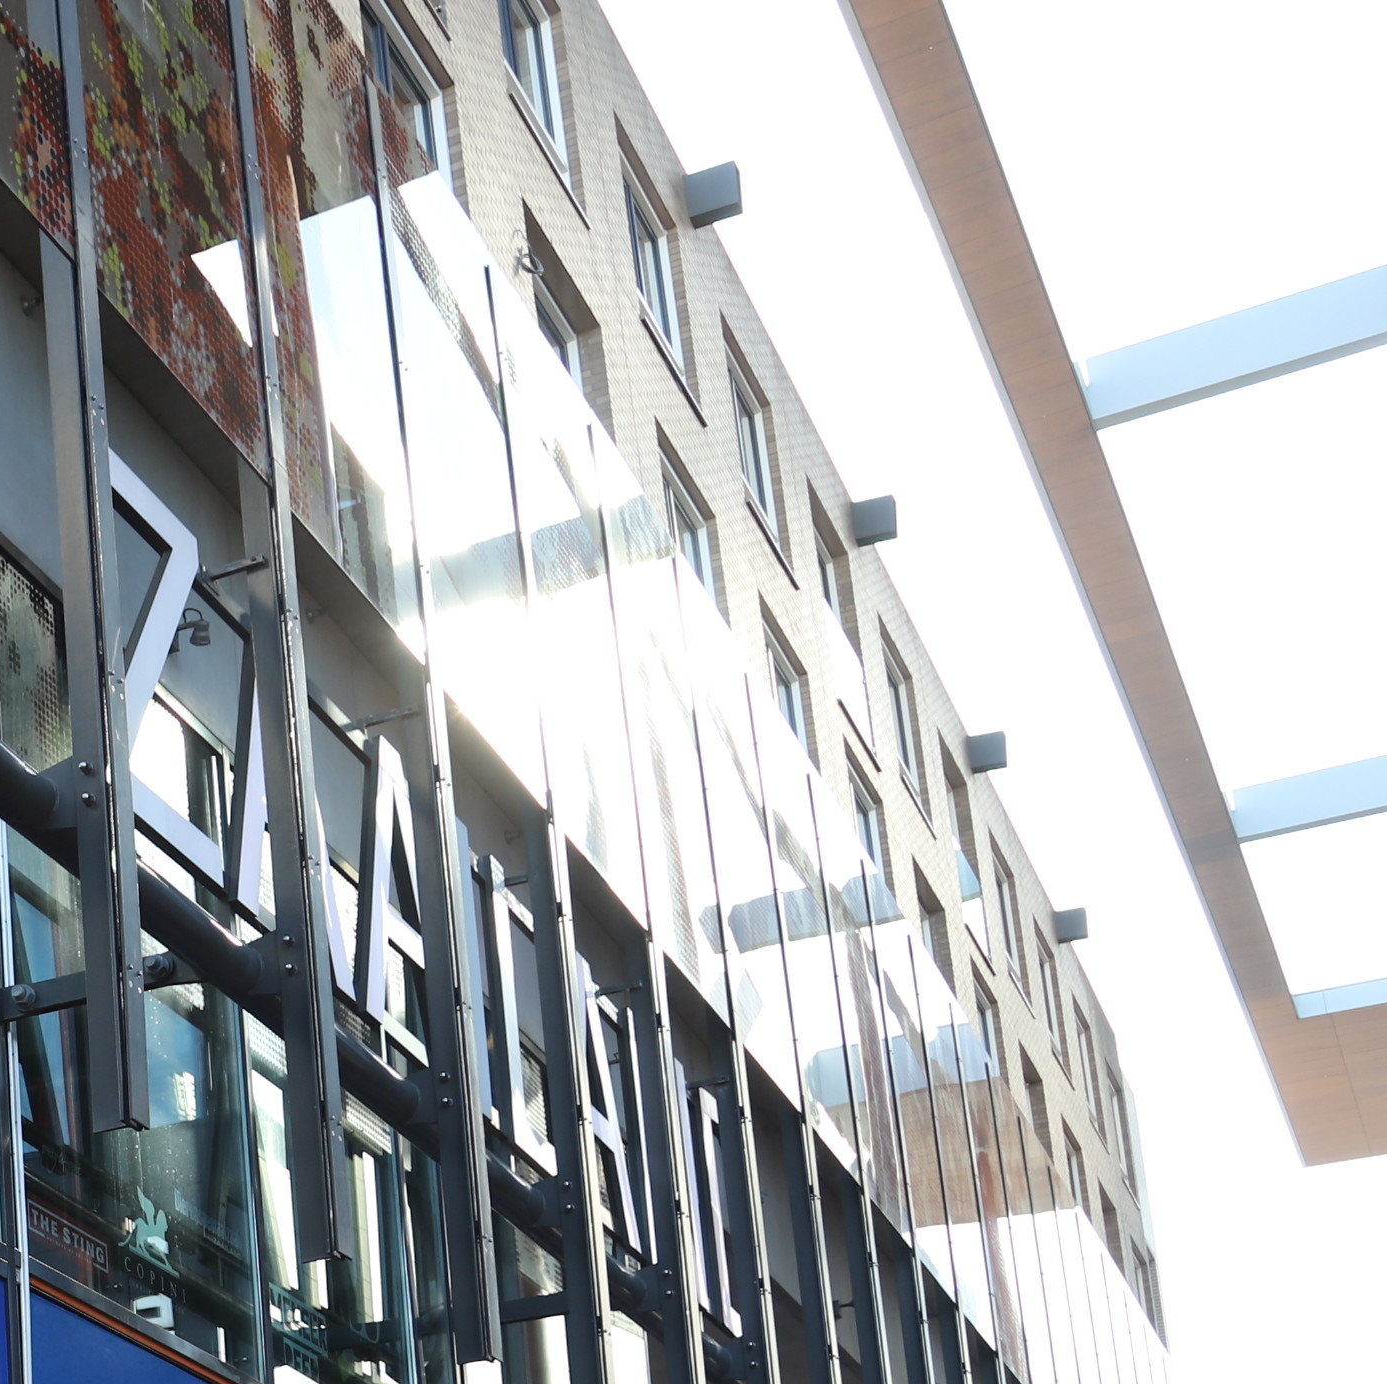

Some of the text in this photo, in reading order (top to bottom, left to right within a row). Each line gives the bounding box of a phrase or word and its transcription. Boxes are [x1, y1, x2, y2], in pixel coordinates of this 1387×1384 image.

[30, 1209, 59, 1236] THE
[62, 1226, 105, 1264] STING
[123, 1256, 188, 1304] COPINI
